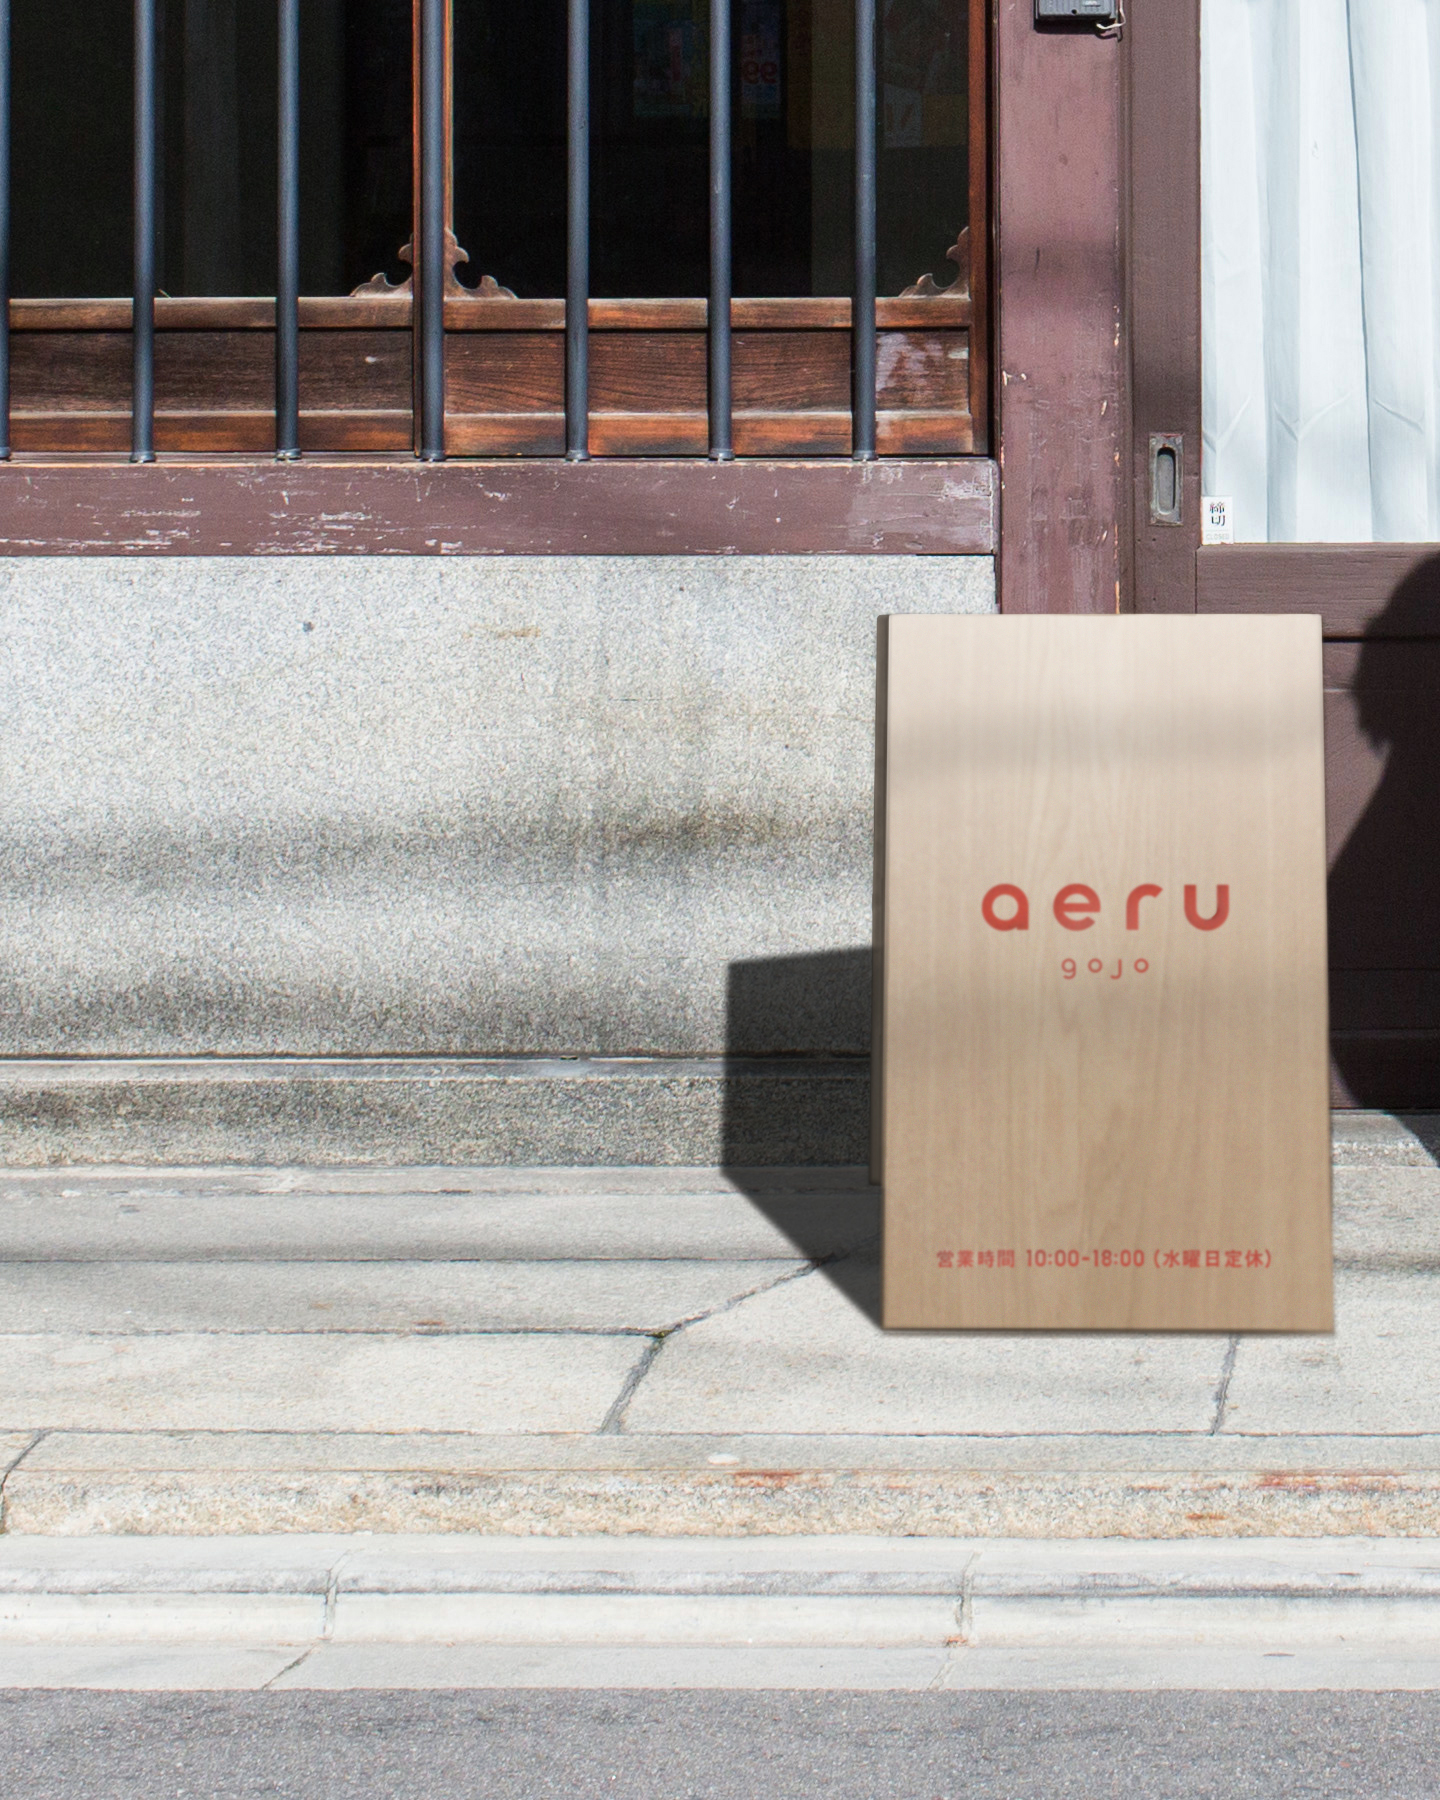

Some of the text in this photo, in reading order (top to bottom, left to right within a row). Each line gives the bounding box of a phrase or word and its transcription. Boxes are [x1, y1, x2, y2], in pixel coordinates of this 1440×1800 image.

[981, 883, 1230, 931] aeru
[1061, 957, 1149, 980] gojo
[936, 1250, 1272, 1269] 営業時間 10:00-18:00 (水曜日定休)
